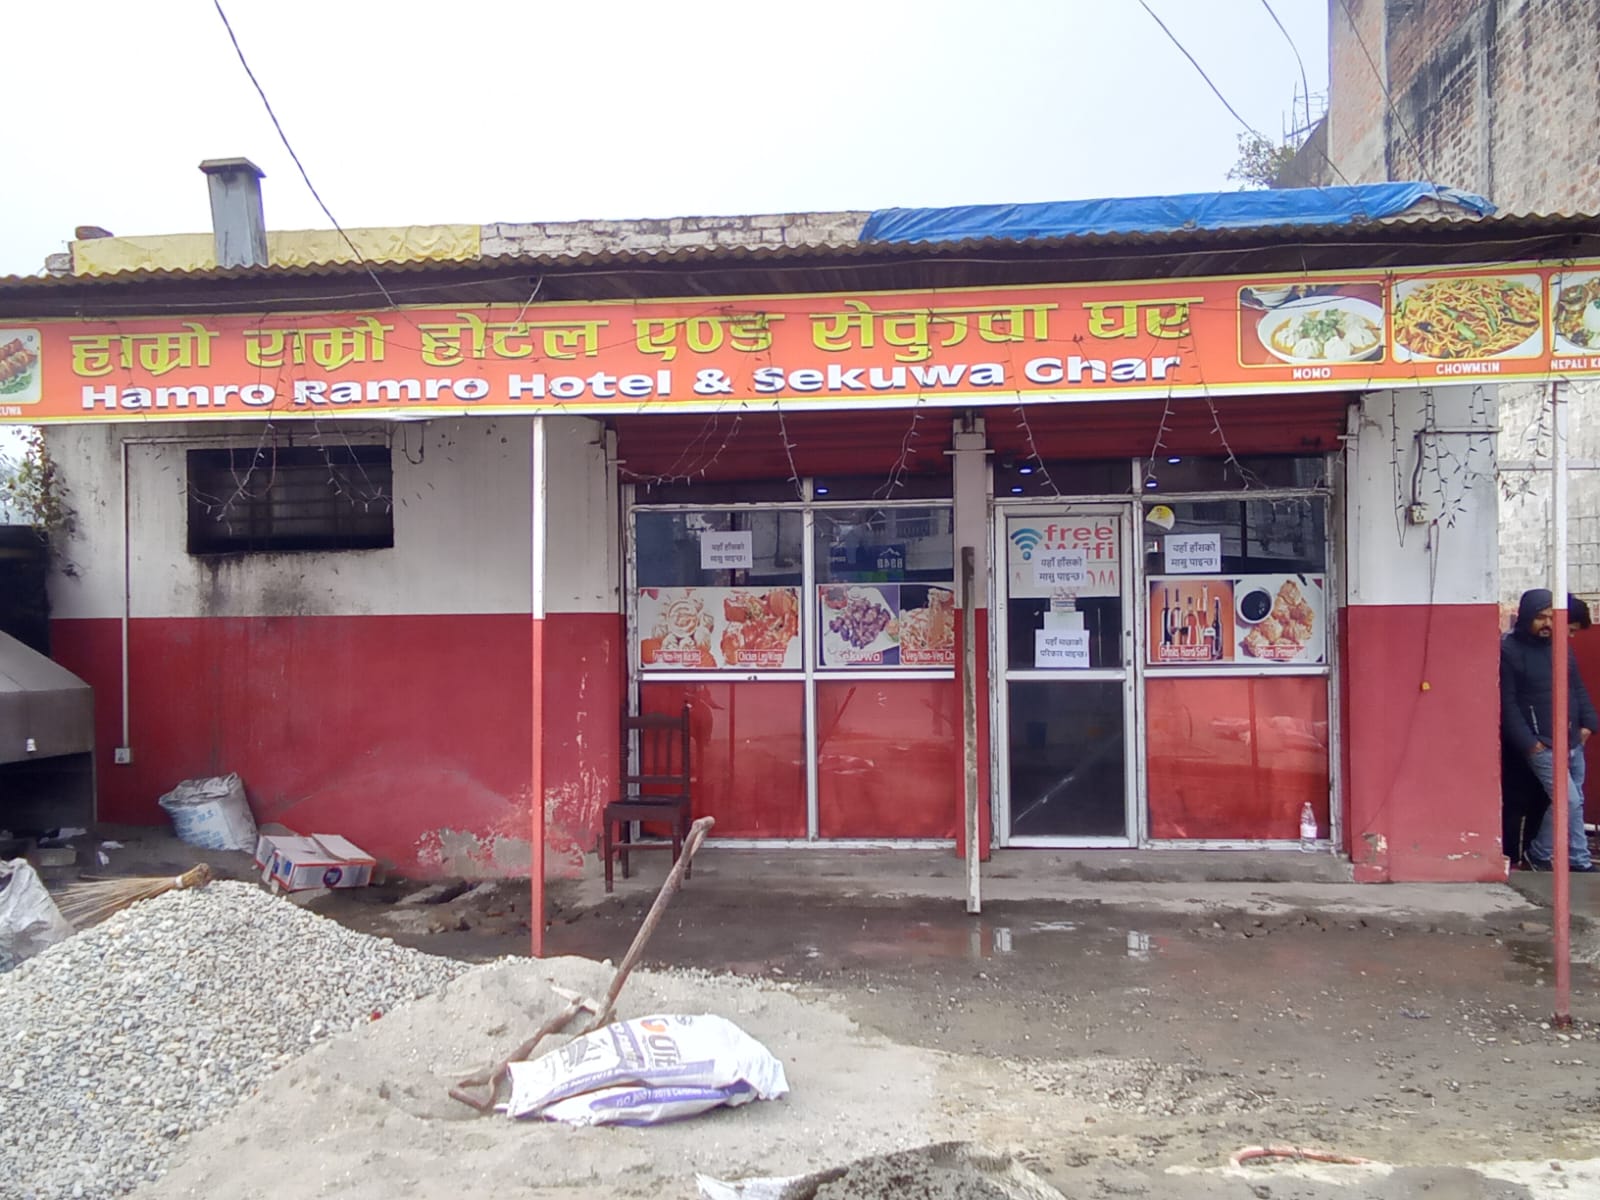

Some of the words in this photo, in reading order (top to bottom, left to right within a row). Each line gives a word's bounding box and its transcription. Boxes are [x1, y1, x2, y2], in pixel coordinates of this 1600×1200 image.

[69, 321, 220, 377] हाम्रो
[242, 315, 395, 372] राम्रो
[418, 312, 610, 367] होटल
[632, 312, 786, 361] एण्ड
[809, 299, 1059, 363] सेकुवा
[1082, 297, 1204, 339] घर
[1436, 361, 1500, 375] CHOWMEIN
[1551, 357, 1588, 370] NEPALI
[1293, 367, 1331, 380] MOMO
[82, 384, 276, 411] Hamro
[293, 377, 490, 406] Ramro
[508, 369, 672, 400] Hotel
[693, 368, 735, 395] &
[752, 359, 1005, 394] Sekuwa
[1024, 355, 1182, 385] Ghar
[1044, 524, 1114, 542] free
